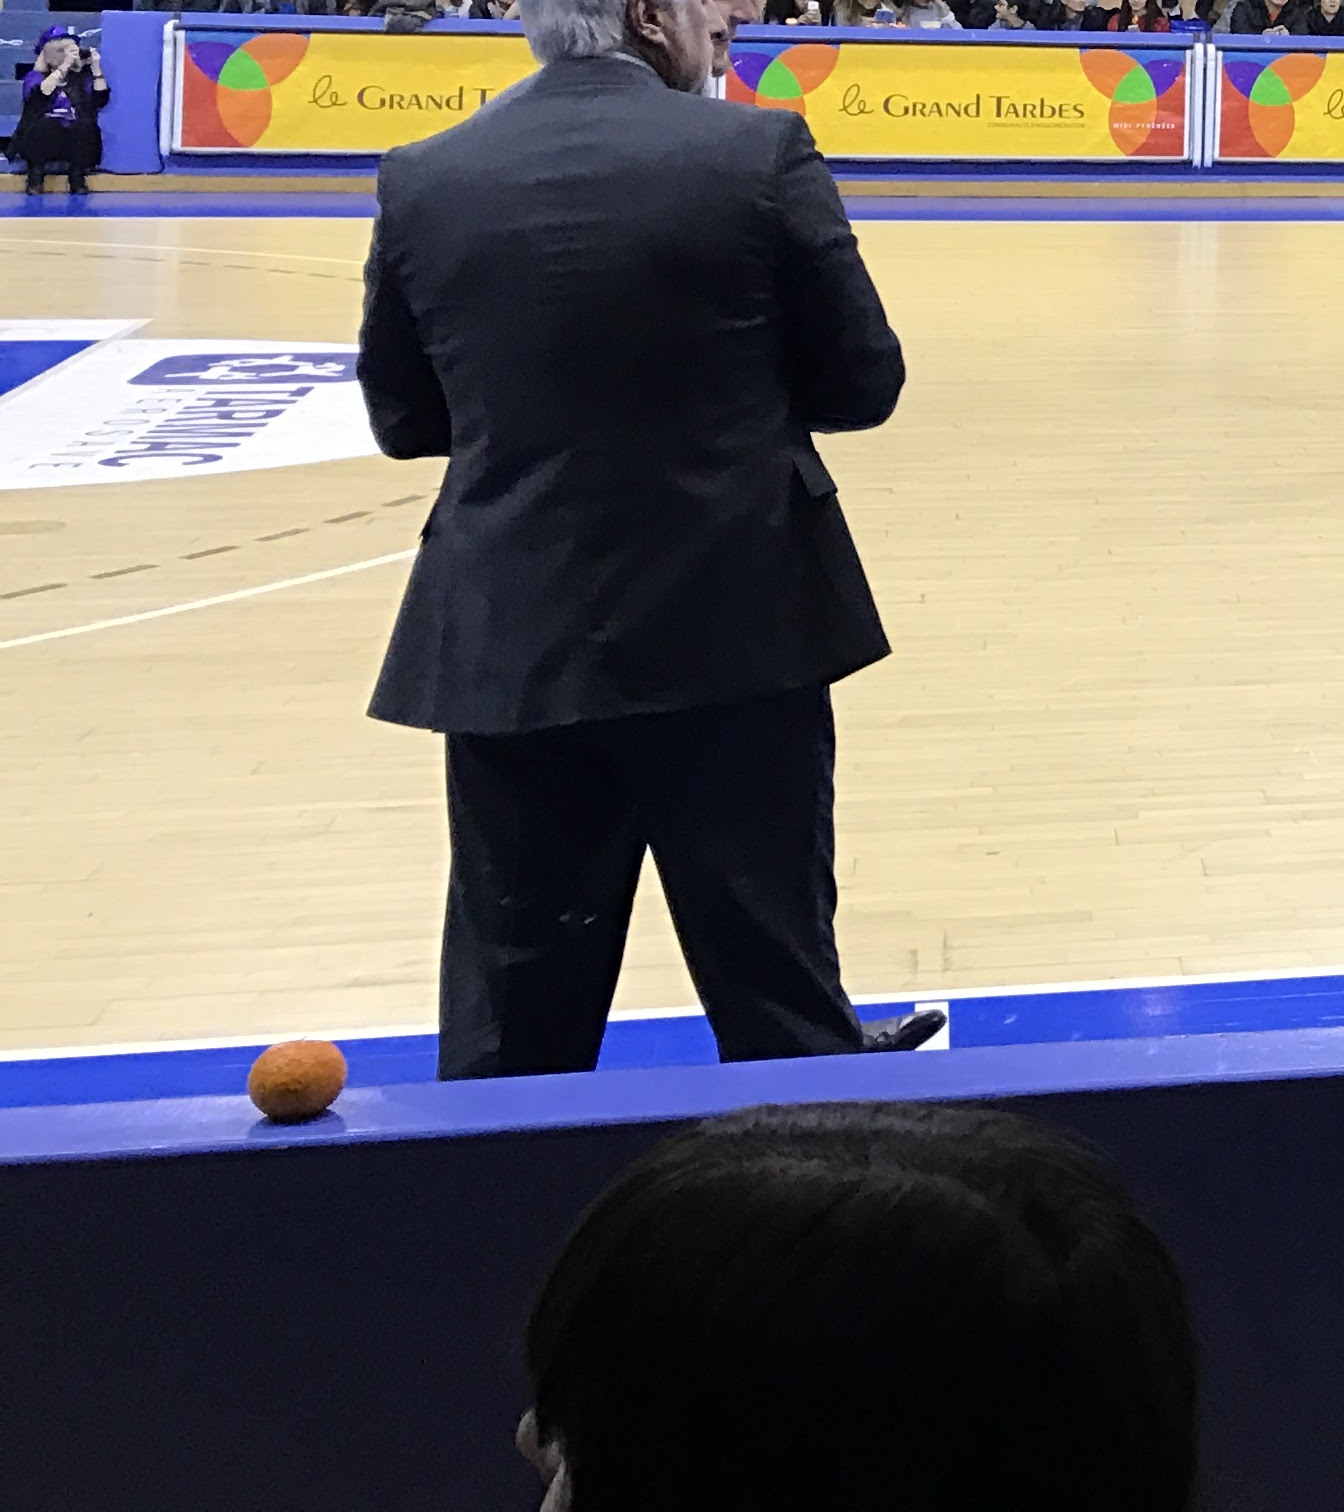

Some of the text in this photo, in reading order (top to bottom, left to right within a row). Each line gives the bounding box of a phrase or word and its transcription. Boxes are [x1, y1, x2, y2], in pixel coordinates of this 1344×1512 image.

[307, 74, 348, 109] le
[838, 83, 875, 117] le
[97, 386, 315, 468] TARMAC
